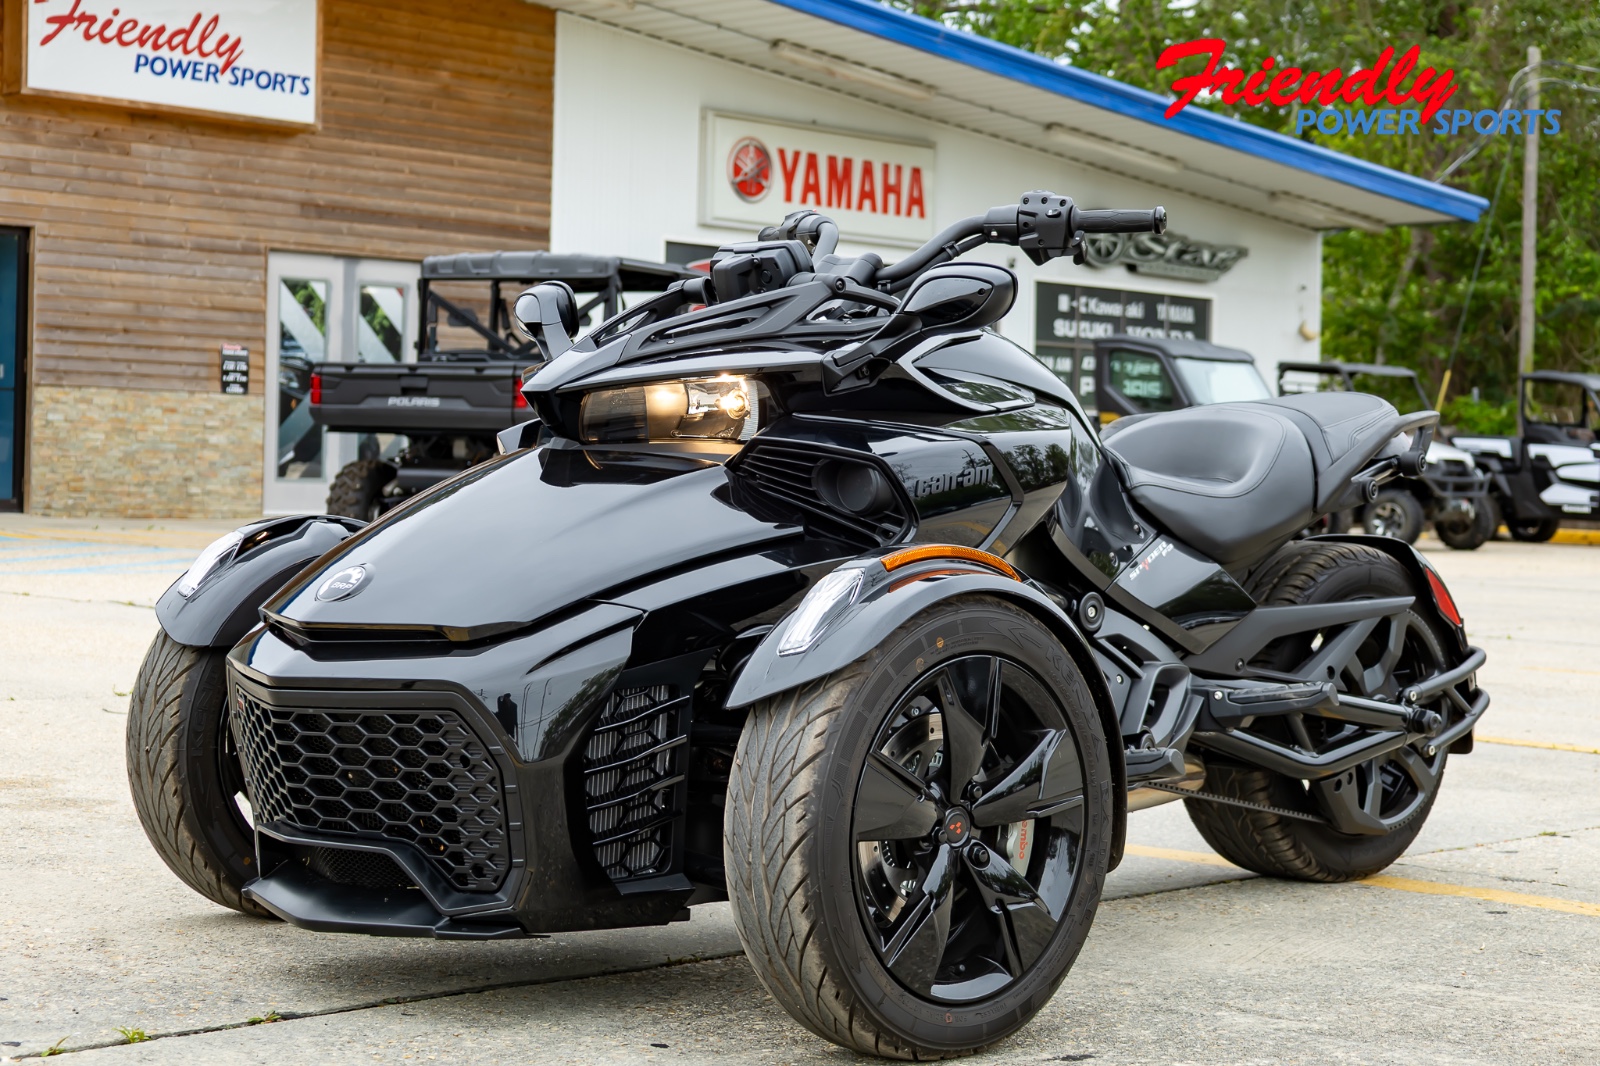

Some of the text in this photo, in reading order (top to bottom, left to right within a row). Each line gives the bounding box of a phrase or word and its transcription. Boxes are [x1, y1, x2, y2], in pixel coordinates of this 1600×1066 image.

[34, 0, 244, 76] Friendly
[134, 53, 312, 96] POWER SPORTS
[776, 146, 926, 219] YAMAHA
[387, 396, 440, 408] POLARIS
[914, 464, 994, 498] can-am
[330, 581, 354, 590] BRP
[1018, 819, 1029, 860] embo
